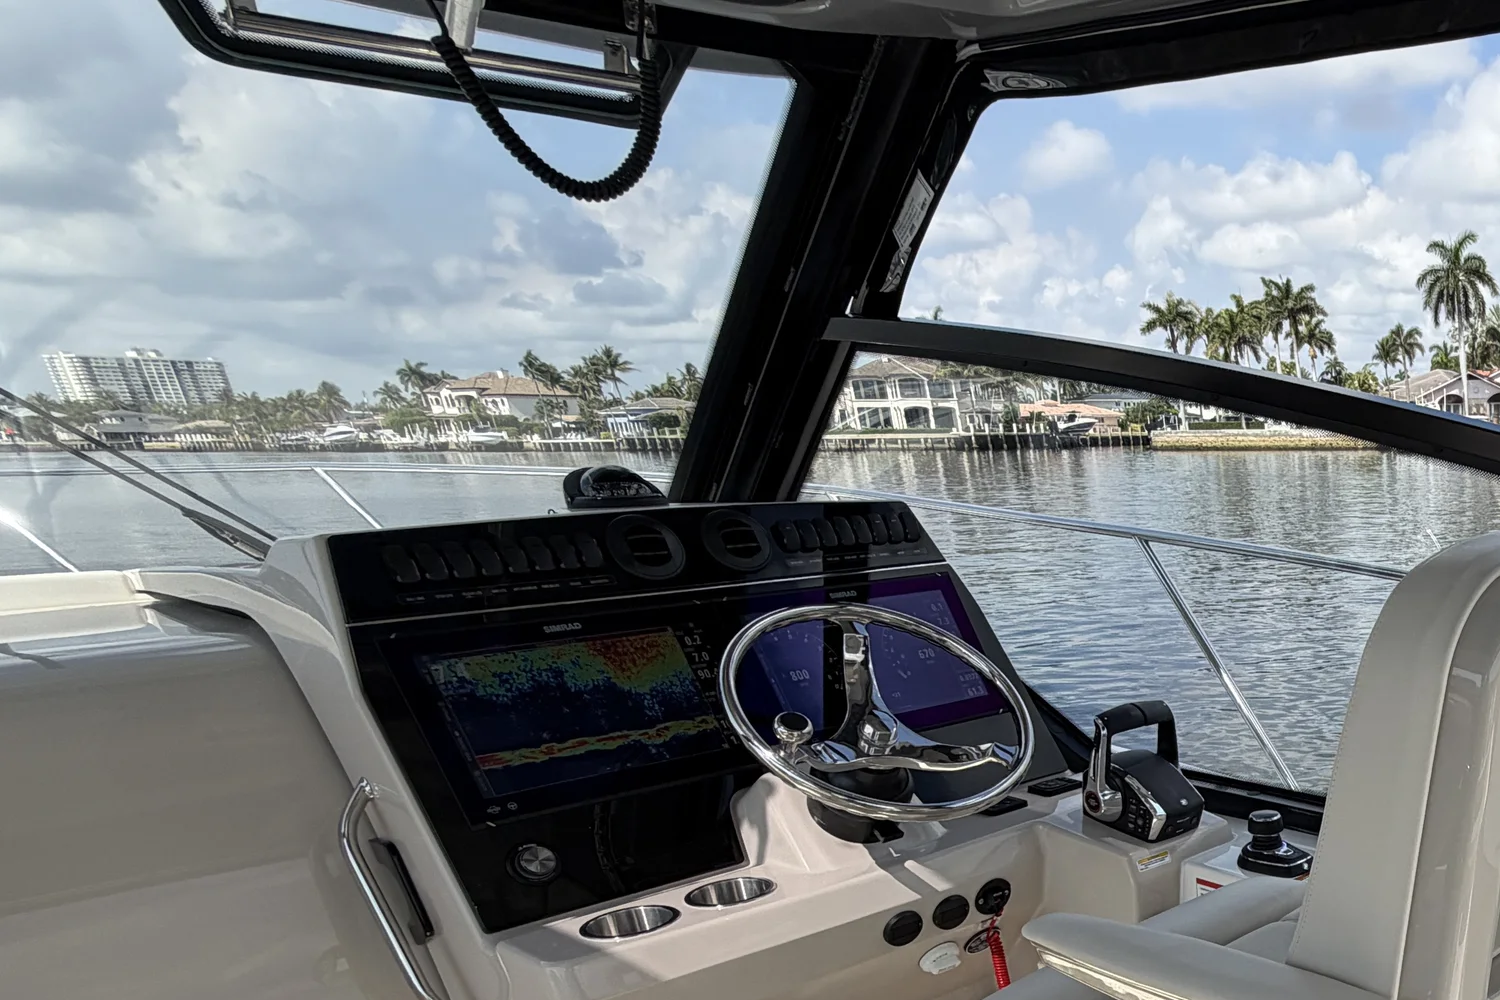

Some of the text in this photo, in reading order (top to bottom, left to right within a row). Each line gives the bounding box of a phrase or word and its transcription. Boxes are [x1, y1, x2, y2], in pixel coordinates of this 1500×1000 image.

[543, 622, 582, 633] SIMRAD
[684, 635, 703, 646] 0.2
[691, 651, 710, 662] 7.0
[918, 647, 936, 659] 670
[789, 668, 810, 681] 800
